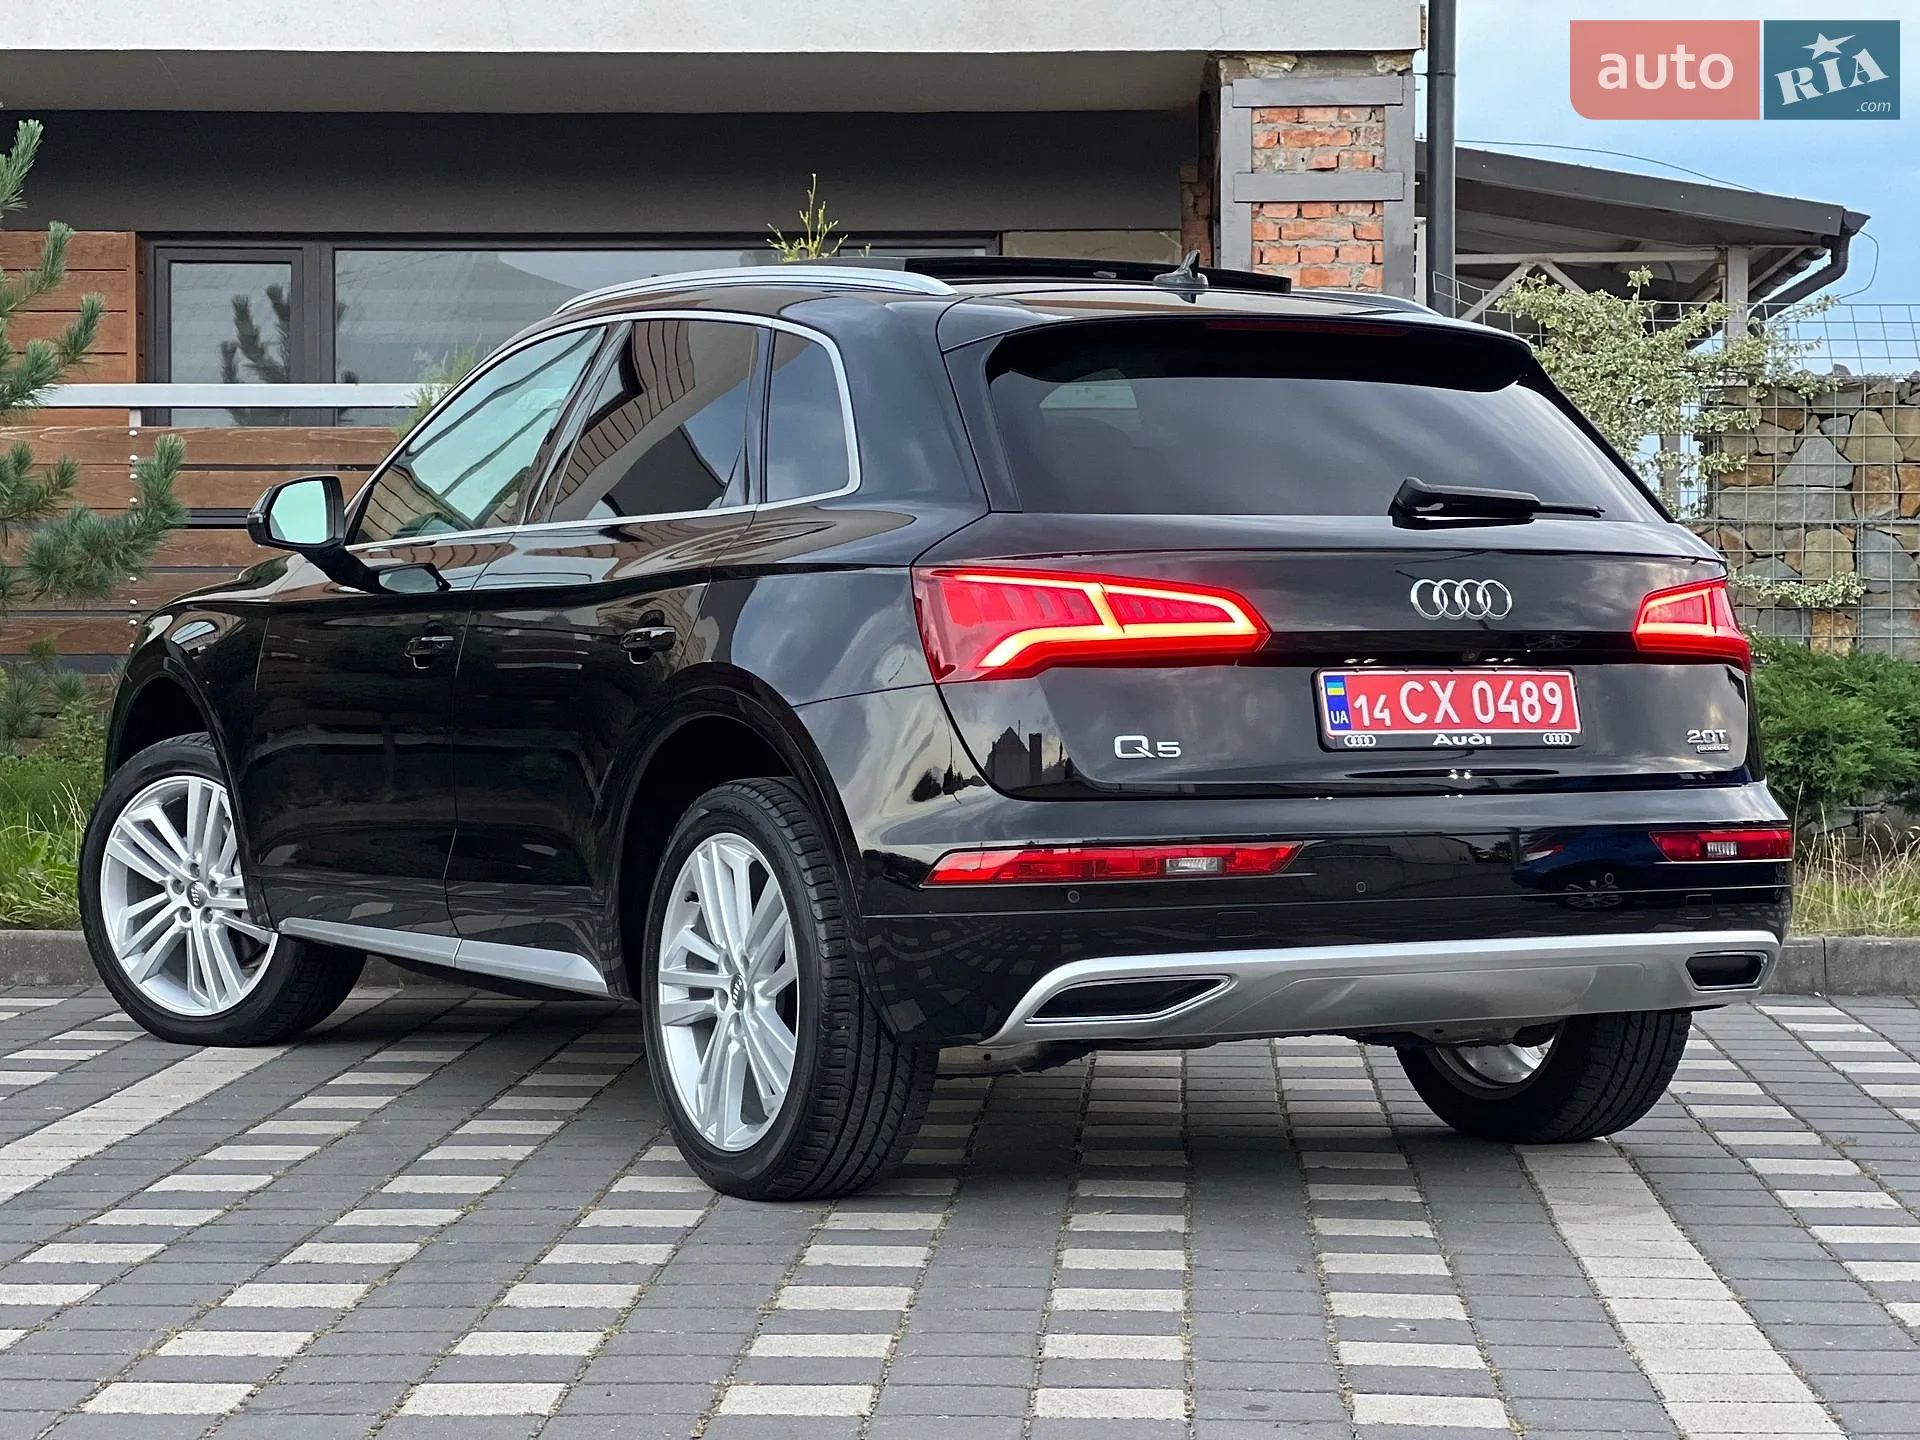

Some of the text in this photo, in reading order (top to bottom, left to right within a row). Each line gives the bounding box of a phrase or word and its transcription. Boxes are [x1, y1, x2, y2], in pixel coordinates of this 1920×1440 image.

[1353, 680, 1563, 727] 14 CX 0489
[1330, 710, 1349, 725] UA
[1114, 735, 1182, 759] Q5
[1432, 733, 1492, 746] Audi
